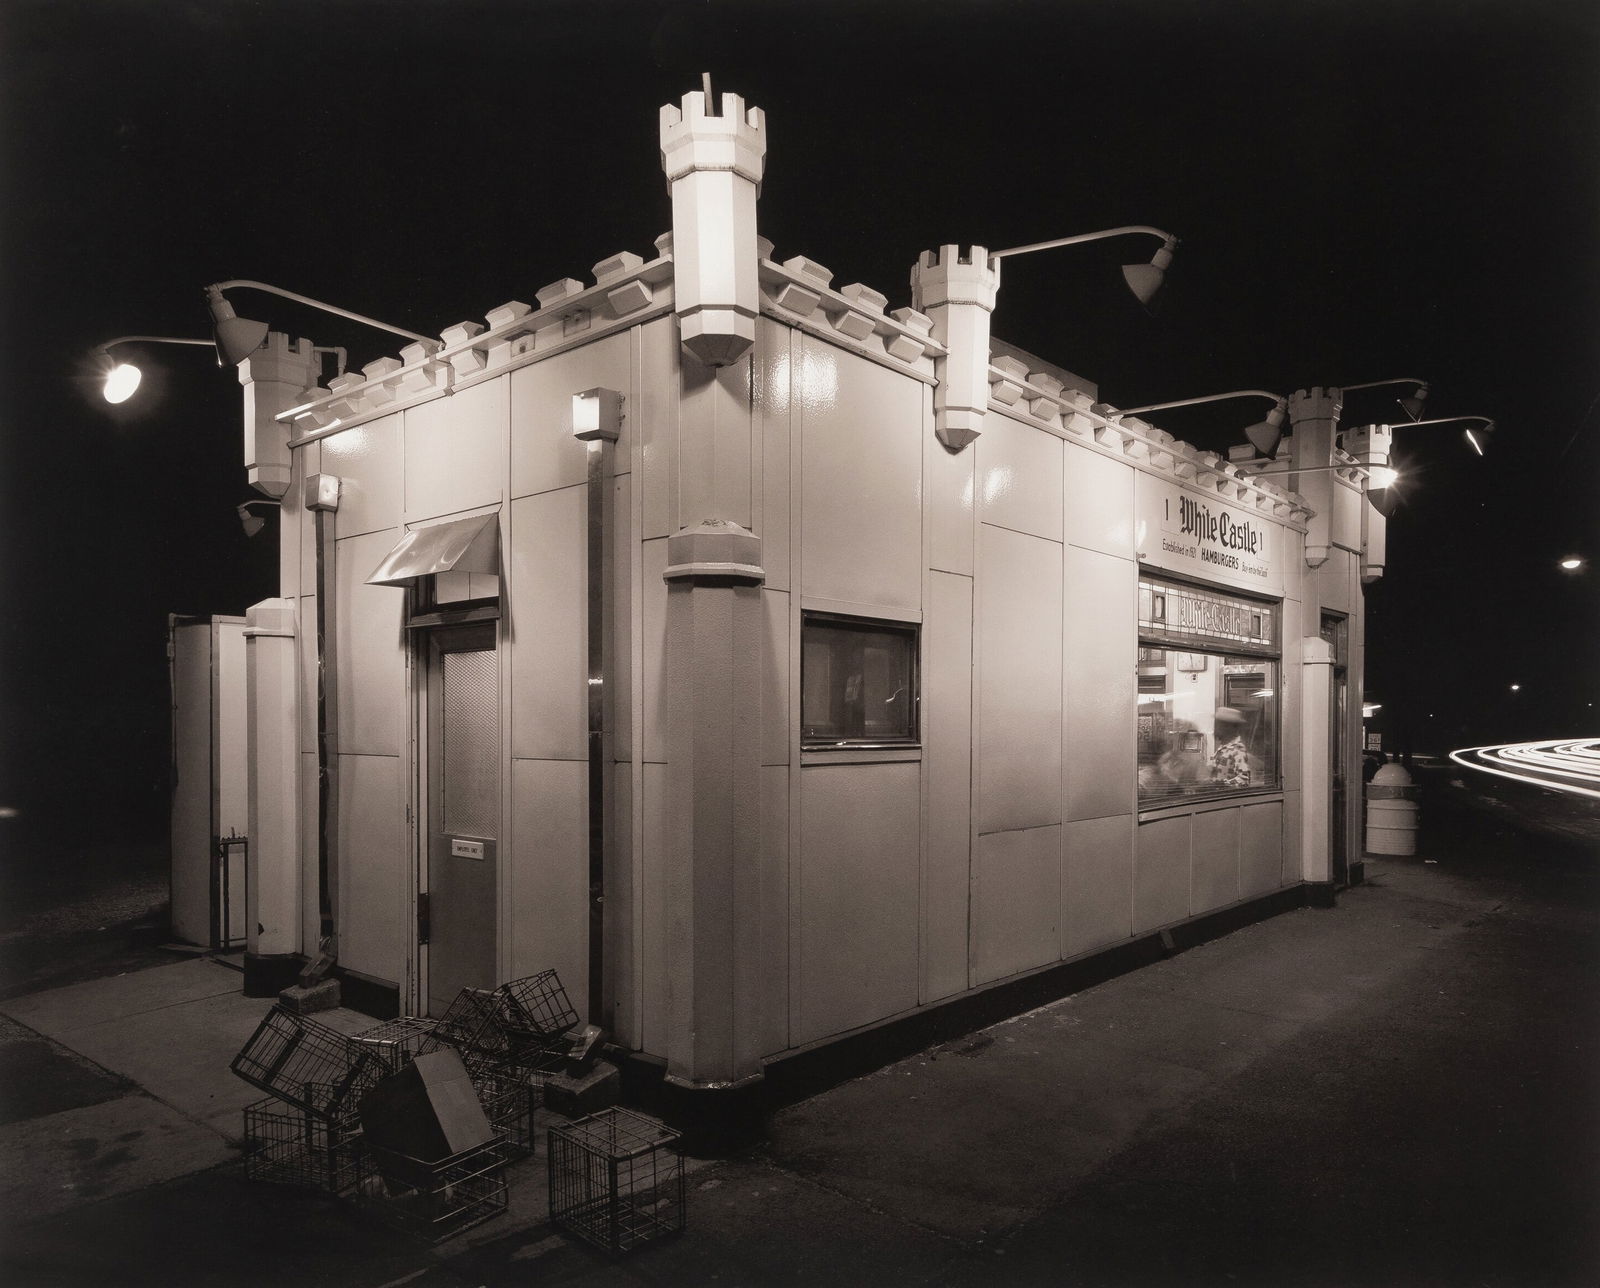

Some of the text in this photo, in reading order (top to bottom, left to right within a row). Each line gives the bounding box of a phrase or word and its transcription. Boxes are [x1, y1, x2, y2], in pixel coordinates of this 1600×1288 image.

[1180, 496, 1257, 555] White Castle
[1201, 547, 1239, 570] HAMBURGERS
